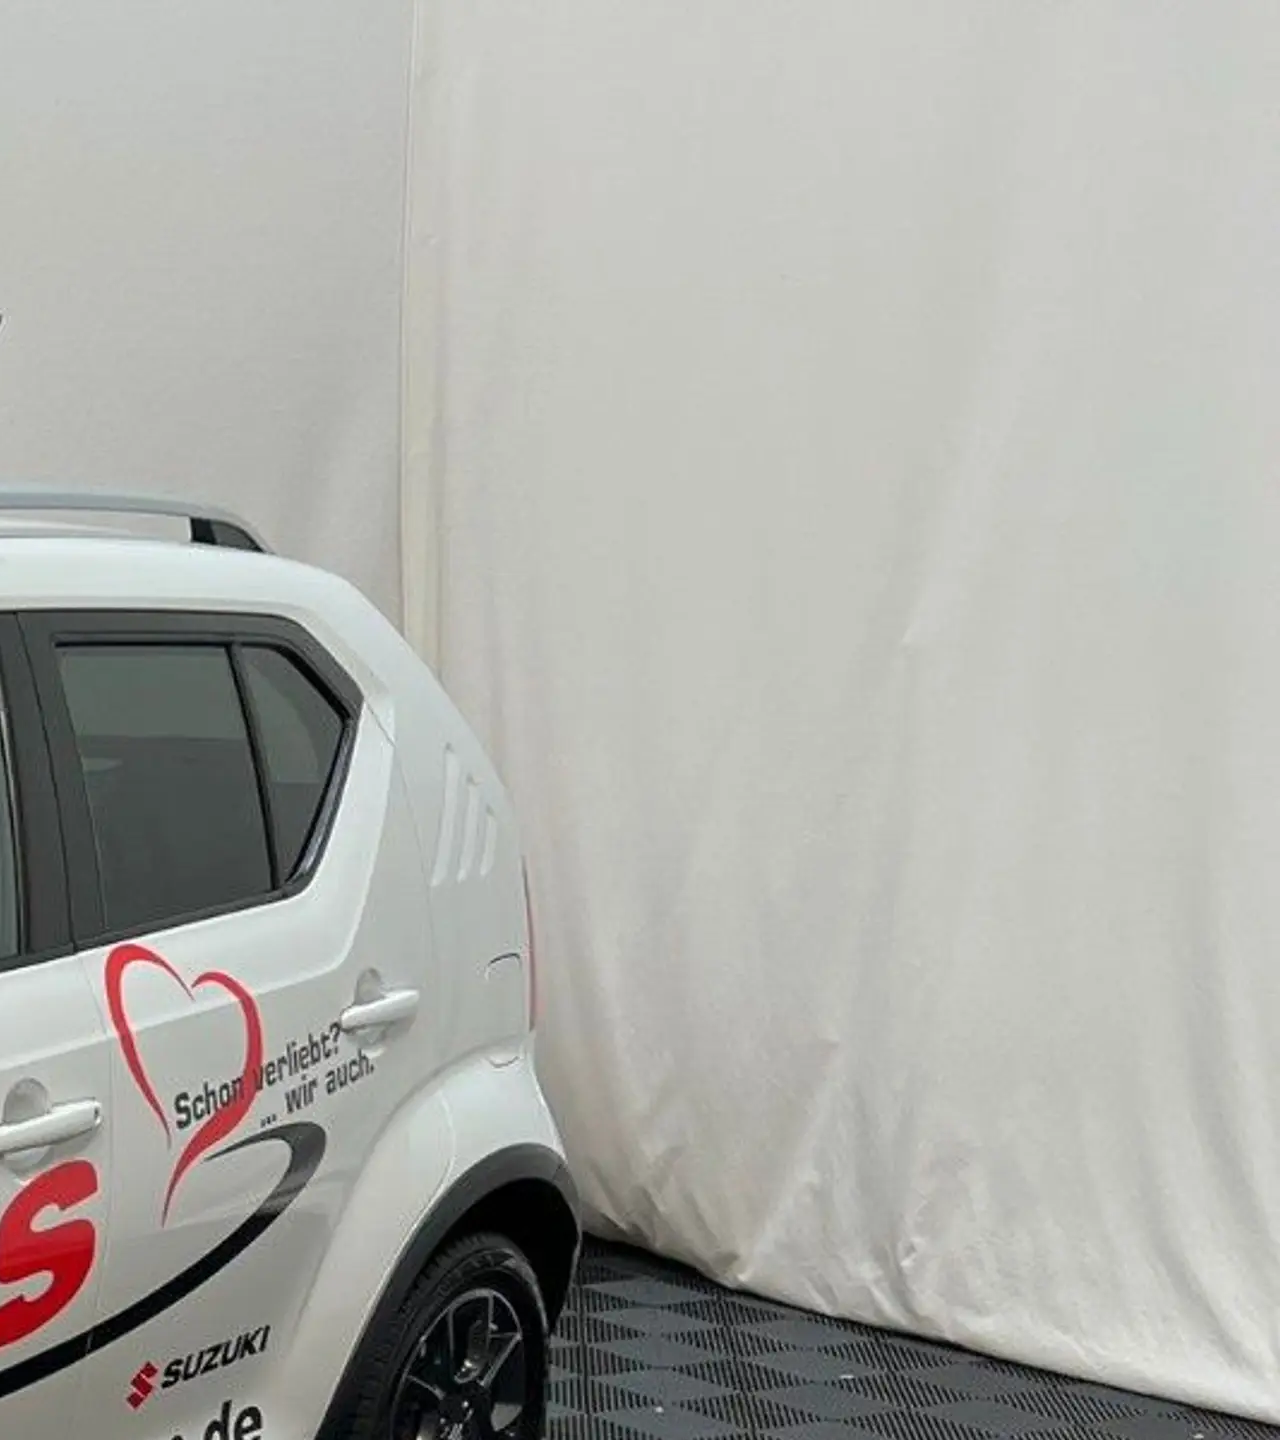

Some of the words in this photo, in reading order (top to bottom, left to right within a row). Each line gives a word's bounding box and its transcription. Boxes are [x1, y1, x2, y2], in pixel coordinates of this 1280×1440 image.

[174, 1073, 246, 1130] Schon
[253, 1021, 342, 1092] verliebt?
[285, 1074, 318, 1115] wir
[325, 1048, 376, 1096] auch.
[160, 1325, 272, 1391] SUZUKI
